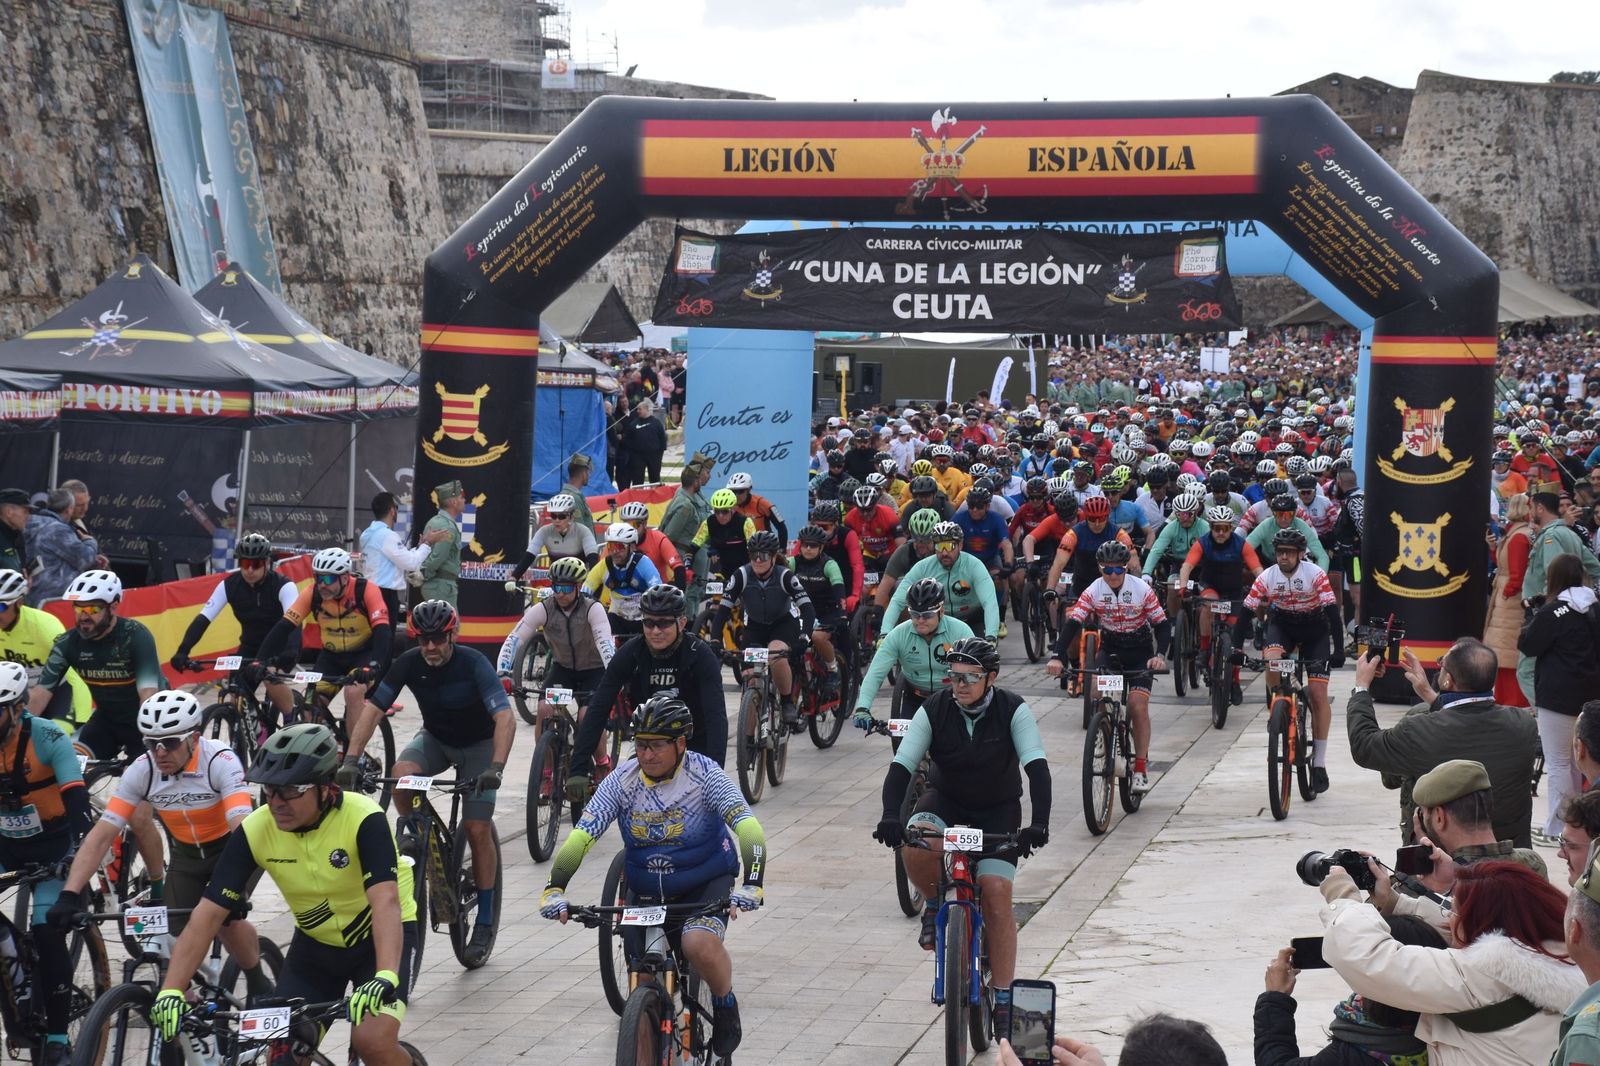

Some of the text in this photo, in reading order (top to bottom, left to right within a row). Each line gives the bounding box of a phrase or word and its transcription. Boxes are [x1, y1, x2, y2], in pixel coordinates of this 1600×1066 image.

[724, 141, 1196, 172] LEGIÓN ESPAÑOLA
[514, 192, 529, 216] del
[528, 145, 588, 200] Legionario
[1365, 196, 1382, 209] de
[1378, 207, 1394, 220] la
[1392, 215, 1441, 266] Muerte
[866, 236, 1022, 250] CARRERA CÍVICO-MILITAR
[895, 263, 928, 284] DE
[938, 263, 970, 284] LA
[893, 294, 993, 319] CEUTA
[62, 383, 222, 416] EPORTIVO
[698, 402, 792, 429] Ceuta es
[700, 441, 792, 475] Deporte
[5, 815, 32, 827] 336
[960, 834, 978, 844] 559
[142, 915, 162, 926] 541
[641, 914, 662, 922] 359
[264, 1017, 280, 1030] 60
